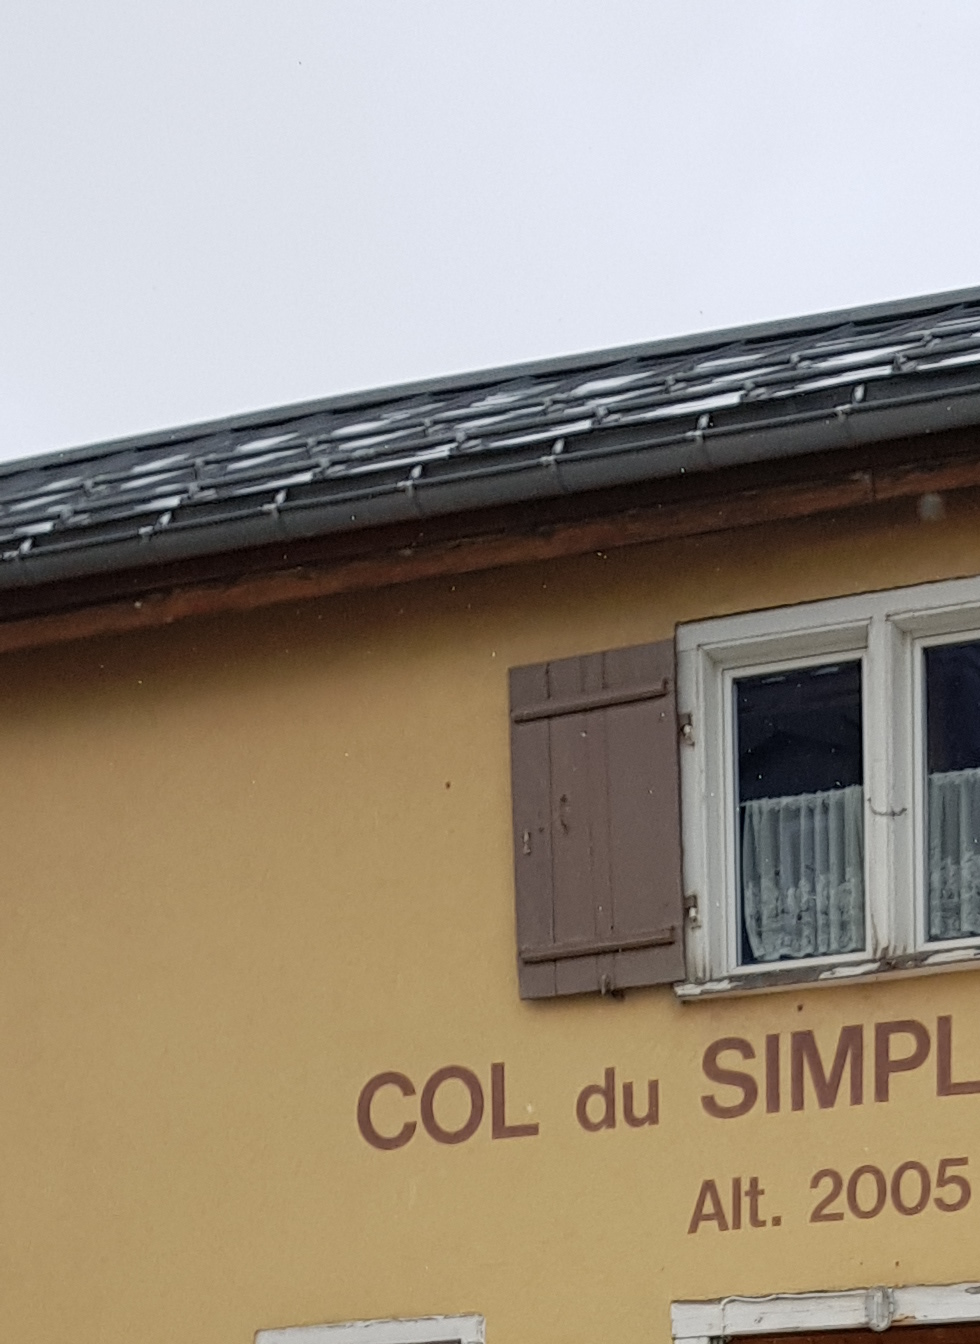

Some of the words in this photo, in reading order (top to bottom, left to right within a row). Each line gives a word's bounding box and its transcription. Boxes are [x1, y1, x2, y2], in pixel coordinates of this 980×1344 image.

[356, 1061, 539, 1152] COL
[576, 1066, 659, 1132] du
[688, 1176, 783, 1232] Alt.
[809, 1156, 972, 1223] 2005
